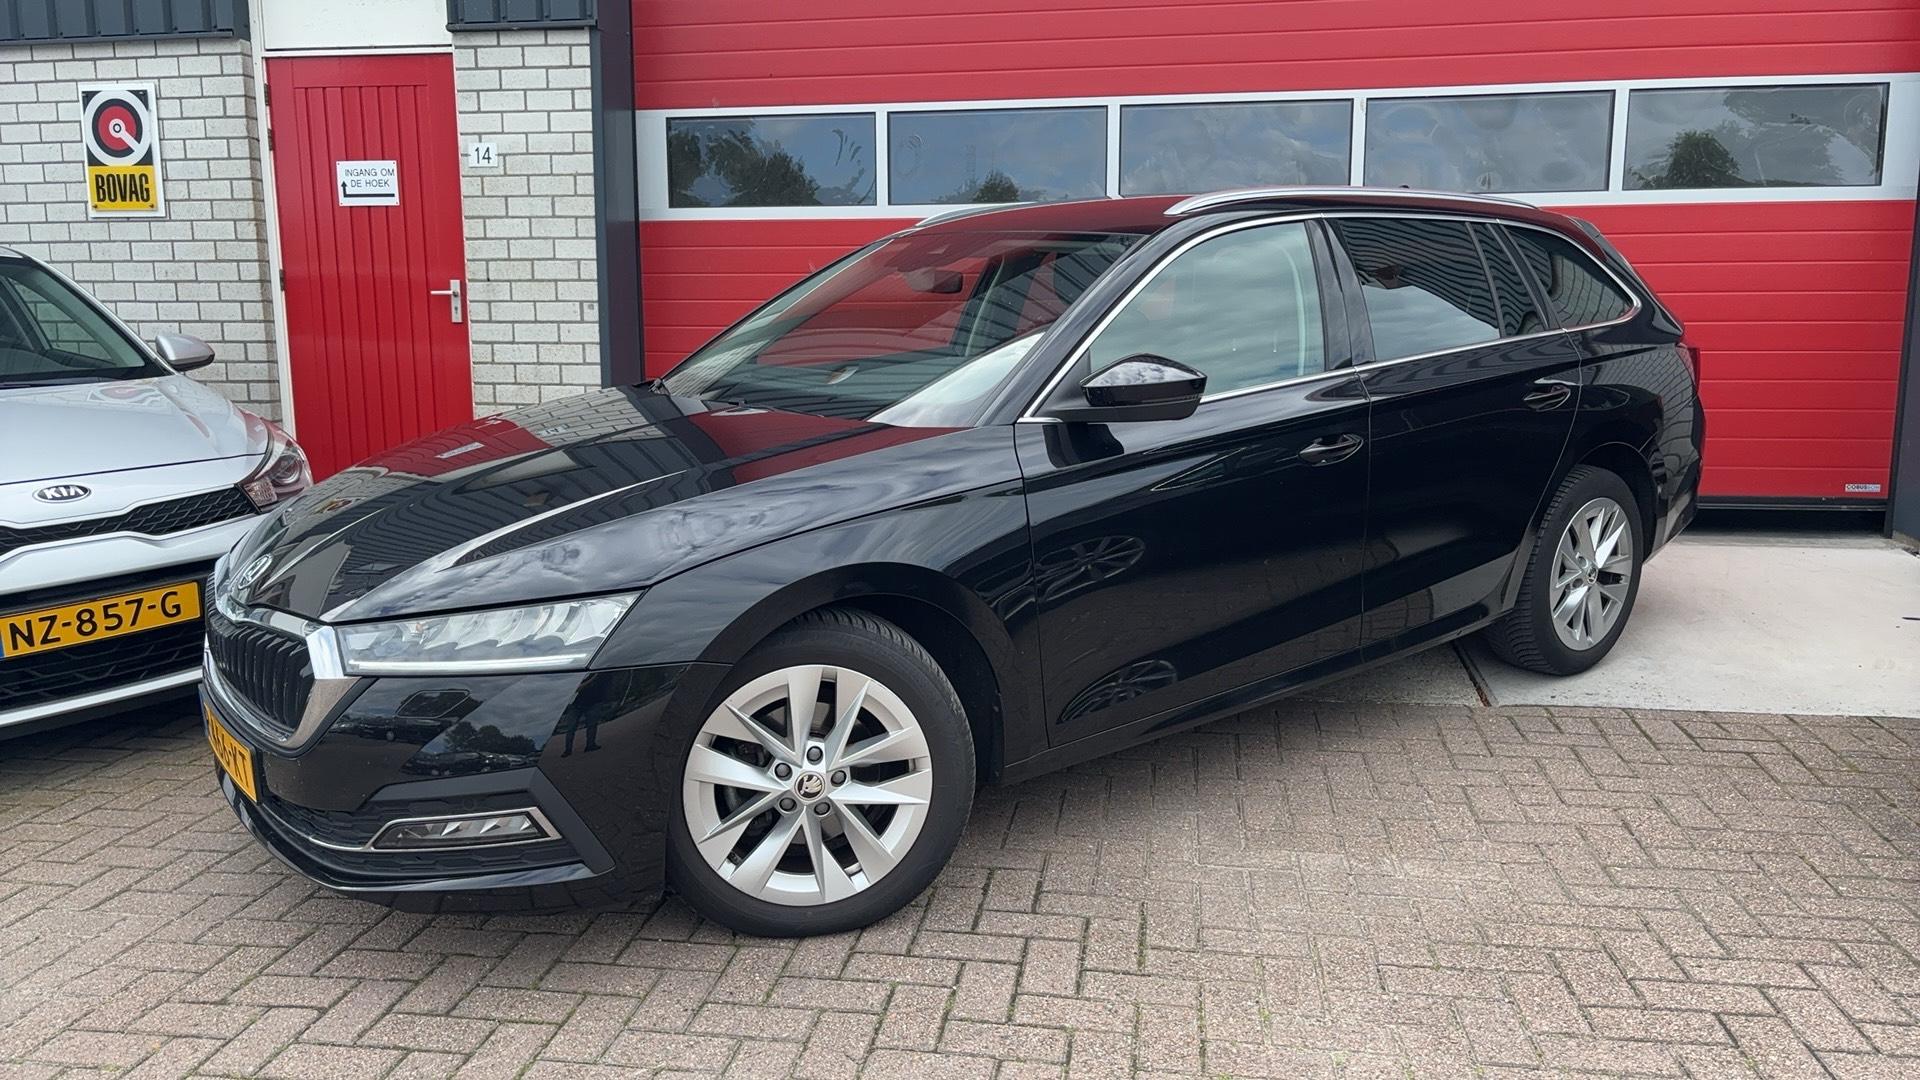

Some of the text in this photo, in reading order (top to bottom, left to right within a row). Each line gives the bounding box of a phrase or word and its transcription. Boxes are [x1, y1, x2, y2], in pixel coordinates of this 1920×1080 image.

[474, 146, 492, 164] 14
[344, 168, 395, 177] INGANG OM
[94, 173, 151, 203] BOVAG
[350, 179, 390, 188] DE HOEK
[45, 485, 85, 500] KIA
[8, 591, 182, 650] NZ-857-G
